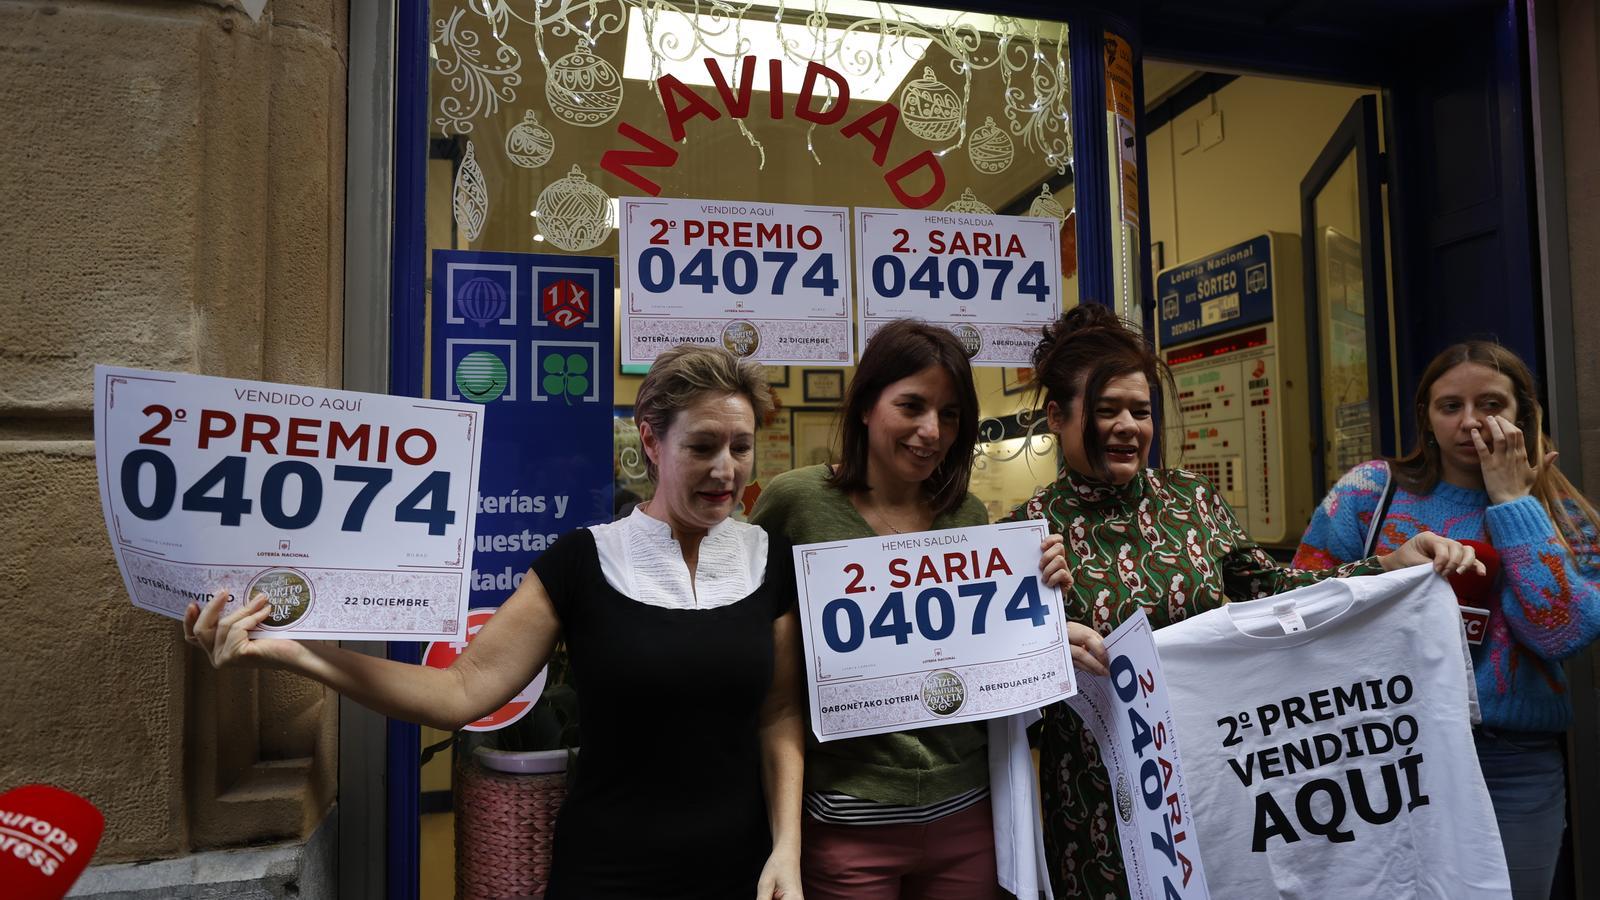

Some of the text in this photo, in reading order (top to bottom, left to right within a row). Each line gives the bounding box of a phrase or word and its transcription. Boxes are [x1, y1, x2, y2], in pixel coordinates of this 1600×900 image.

[600, 55, 946, 209] NAVIDAD
[701, 205, 775, 218] VENDIDO AQUÍ
[925, 215, 994, 227] HEMEN SALDUA
[650, 218, 823, 250] 2º PREMIO
[892, 228, 1026, 258] 2. SARIA
[638, 247, 839, 296] 04074
[1207, 245, 1254, 271] Nacional
[872, 254, 1050, 302] 04074
[1197, 270, 1237, 299] SORTEO
[638, 334, 670, 343] LOTERÍA
[234, 387, 363, 413] VENDIDO AQUÍ
[139, 404, 437, 466] 2º PREMIO
[120, 448, 456, 536] 04074
[476, 489, 569, 519] terías y
[881, 534, 968, 551] HEMEN SALDUA
[843, 547, 1013, 594] 2. SARIA
[181, 589, 235, 603] NAVIDD
[344, 596, 430, 607] 22 DICIEMBRE
[822, 576, 1050, 653] 04074
[979, 676, 1039, 692] ABENDUAREN
[821, 694, 919, 714] GABONETAKO LOTERIA
[1217, 674, 1413, 747] 2º PREMIO
[1227, 714, 1419, 788] VENDIDO
[1138, 669, 1194, 890] 2. SARIA
[1252, 747, 1430, 852] AQUÍ
